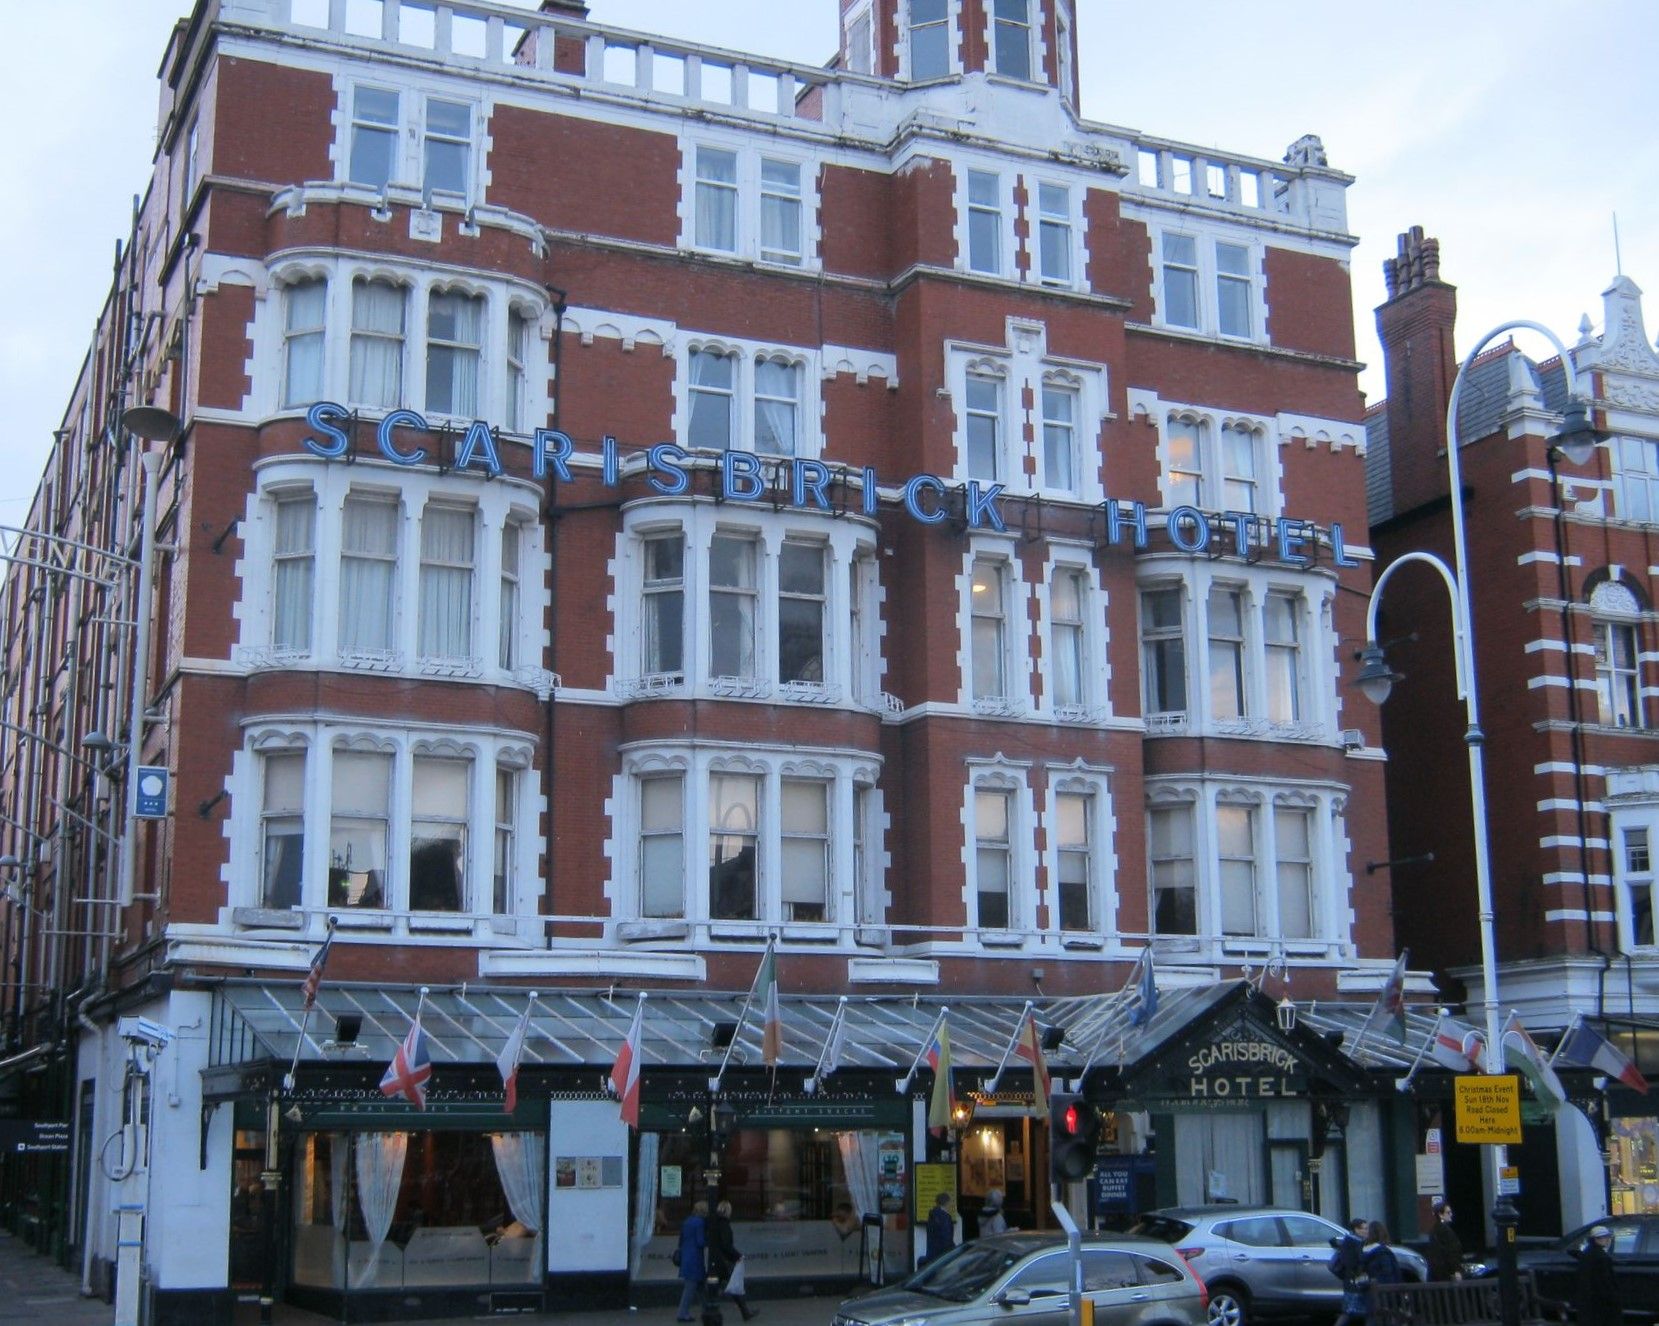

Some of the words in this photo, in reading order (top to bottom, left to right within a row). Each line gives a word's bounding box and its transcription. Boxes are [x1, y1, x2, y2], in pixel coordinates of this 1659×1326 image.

[304, 401, 1007, 532] SCARISBRICK
[1105, 499, 1360, 568] HOTEL
[1189, 1042, 1299, 1075] SCARISBRICK
[1190, 1077, 1297, 1096] HOTEL
[1485, 1105, 1508, 1114] Closed
[1479, 1115, 1496, 1124] Here
